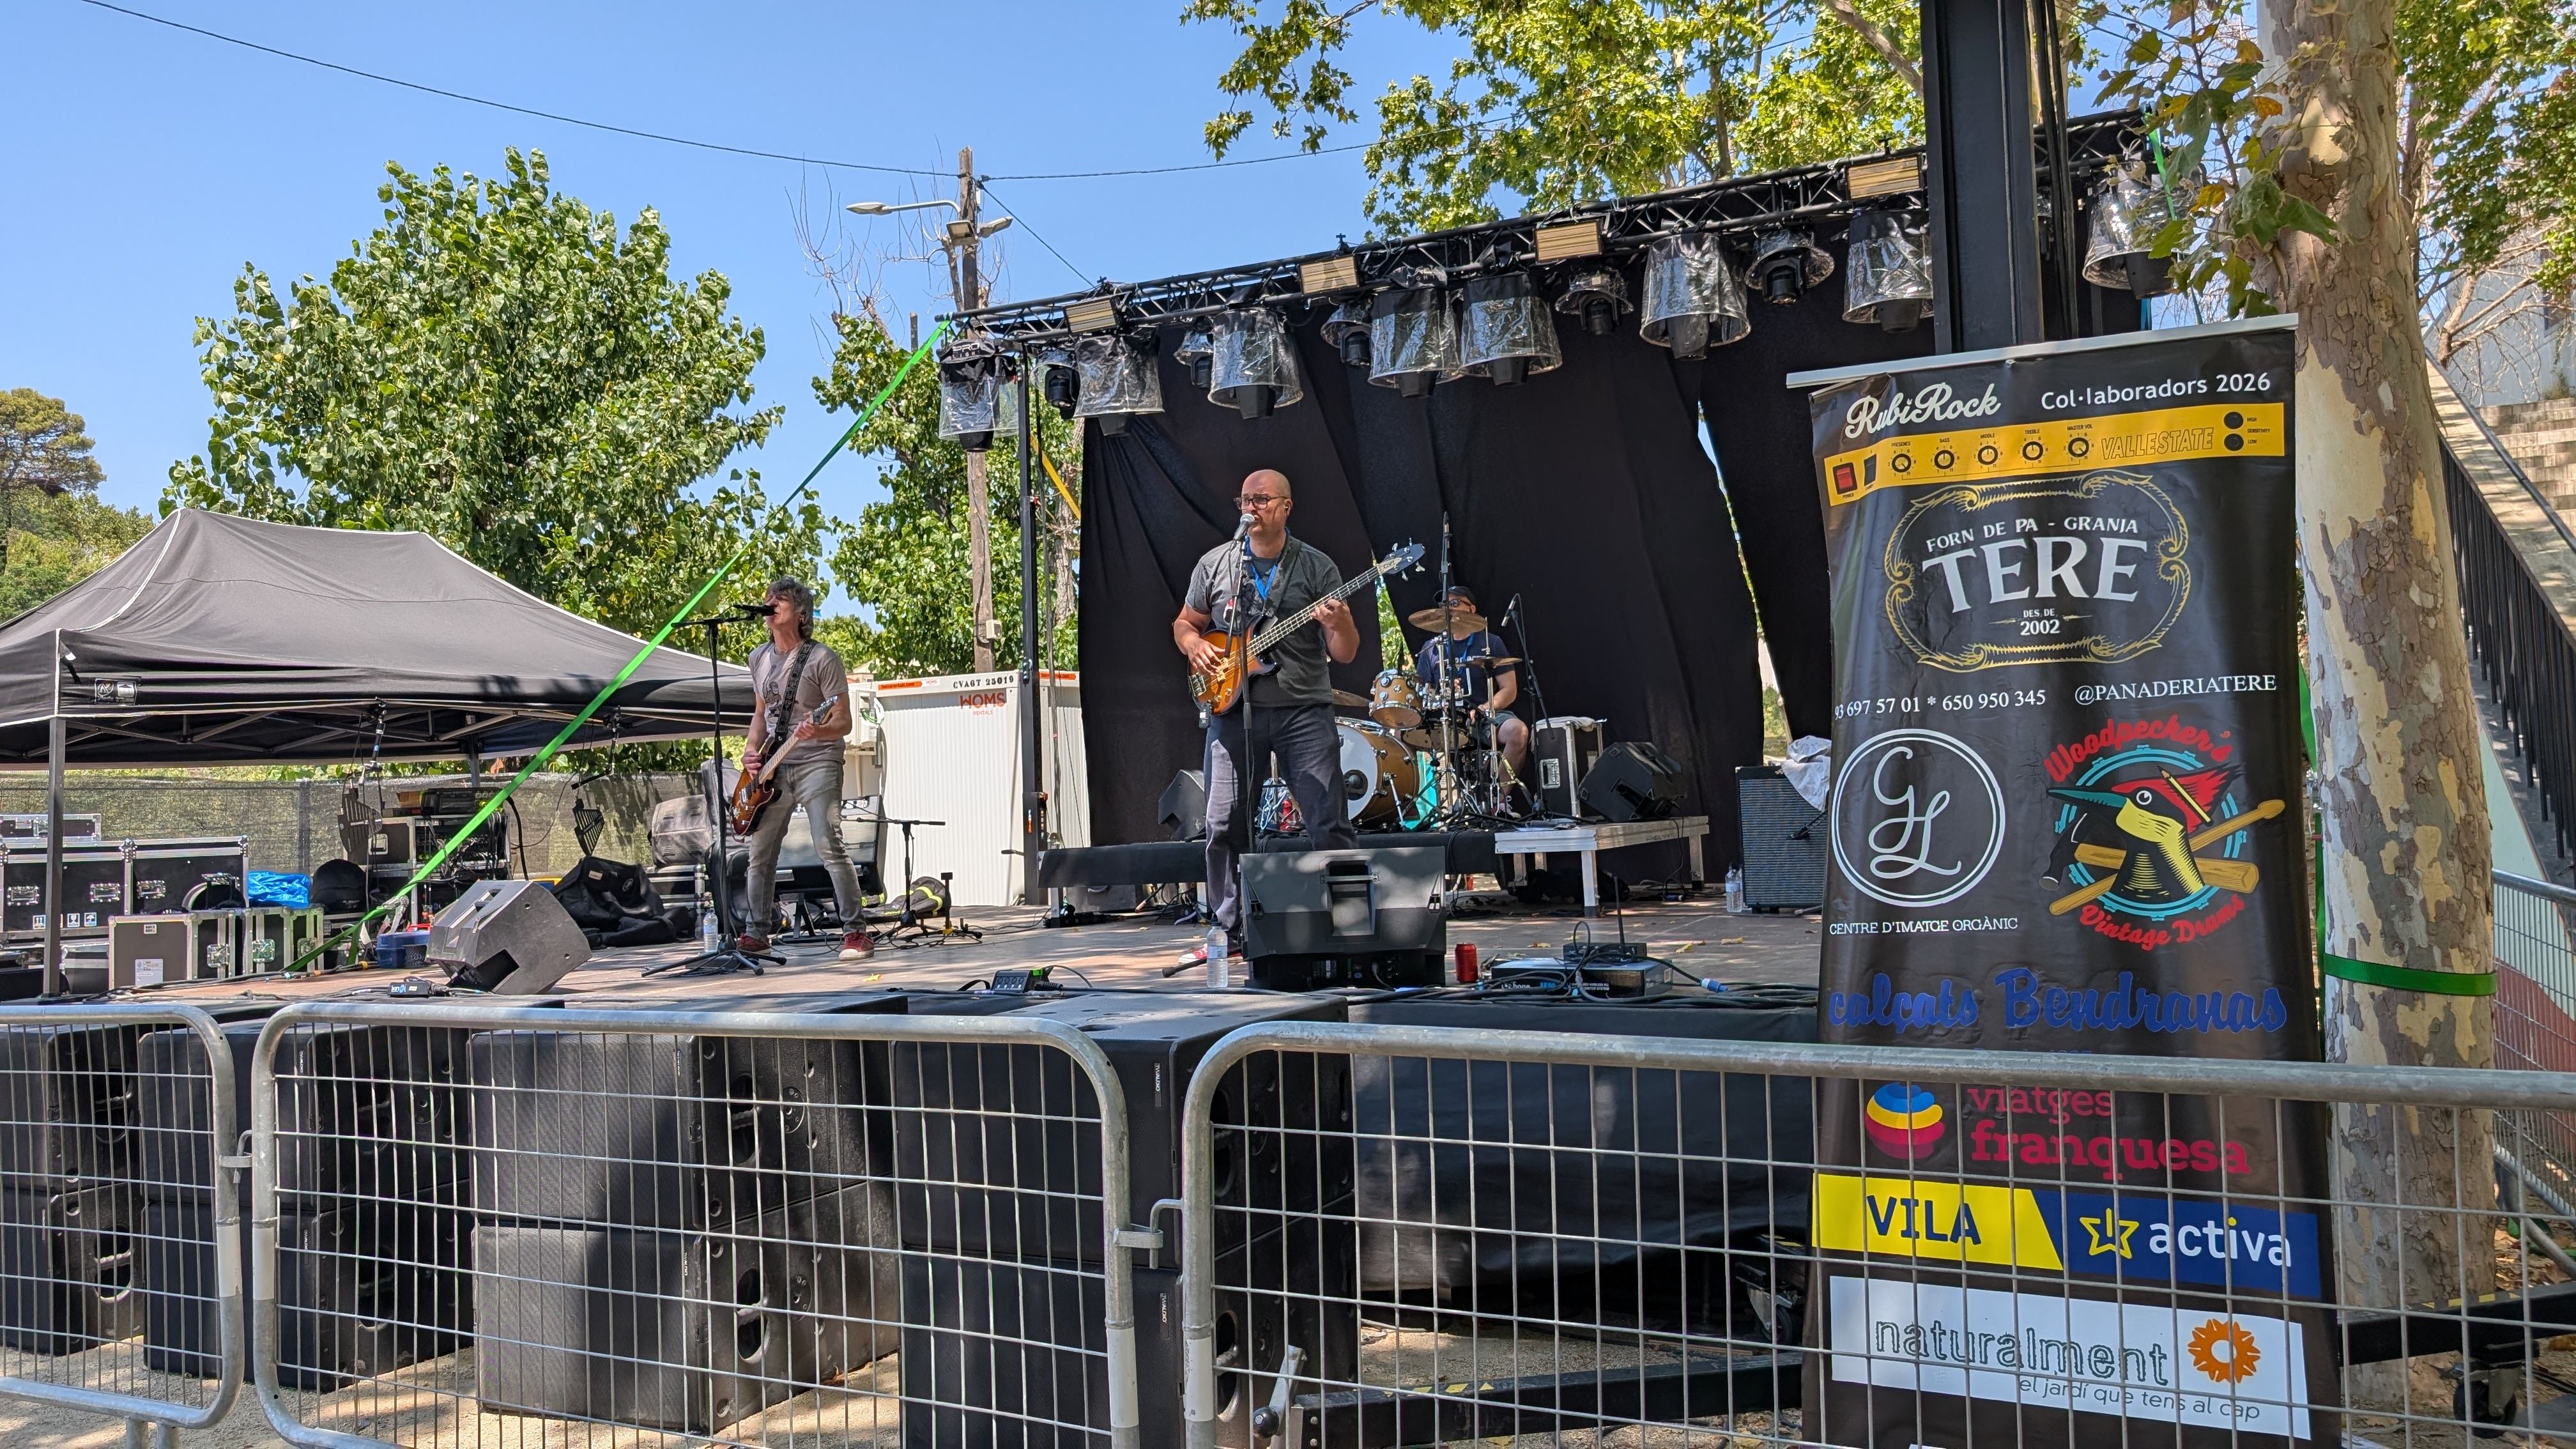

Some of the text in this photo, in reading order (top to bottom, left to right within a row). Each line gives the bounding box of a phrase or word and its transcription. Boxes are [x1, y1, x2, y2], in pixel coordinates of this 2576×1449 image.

[2216, 372, 2271, 392] 2026
[1845, 383, 2001, 438] RubiRock
[2101, 427, 2214, 460] VALLESTATE
[1926, 528, 1974, 553] FORN
[1983, 521, 2006, 539] DE
[2015, 518, 2038, 533] PA
[2064, 516, 2138, 533] GRANJA
[1922, 536, 2147, 613] TERE
[2020, 619, 2060, 636] 2002
[2023, 608, 2055, 618] DES DE
[1835, 689, 2046, 721] 93 697 57 01 650 950 345
[2075, 675, 2276, 705] @PANADERIATERE
[2045, 714, 2232, 783] Woodpecker's
[1829, 916, 2018, 935] CENTRE D'IMATGE ORGÀNIC
[2080, 894, 2244, 951] Vintage Drums
[1828, 967, 2287, 1034] calçats Bendranas
[1967, 1086, 2112, 1125] viatges
[1971, 1120, 2251, 1181] franquesa
[1867, 1194, 1981, 1246] VILA
[2149, 1216, 2292, 1268] activa
[1875, 1319, 2168, 1386] naturalment
[2019, 1372, 2260, 1421] el jardí que tens al cap
